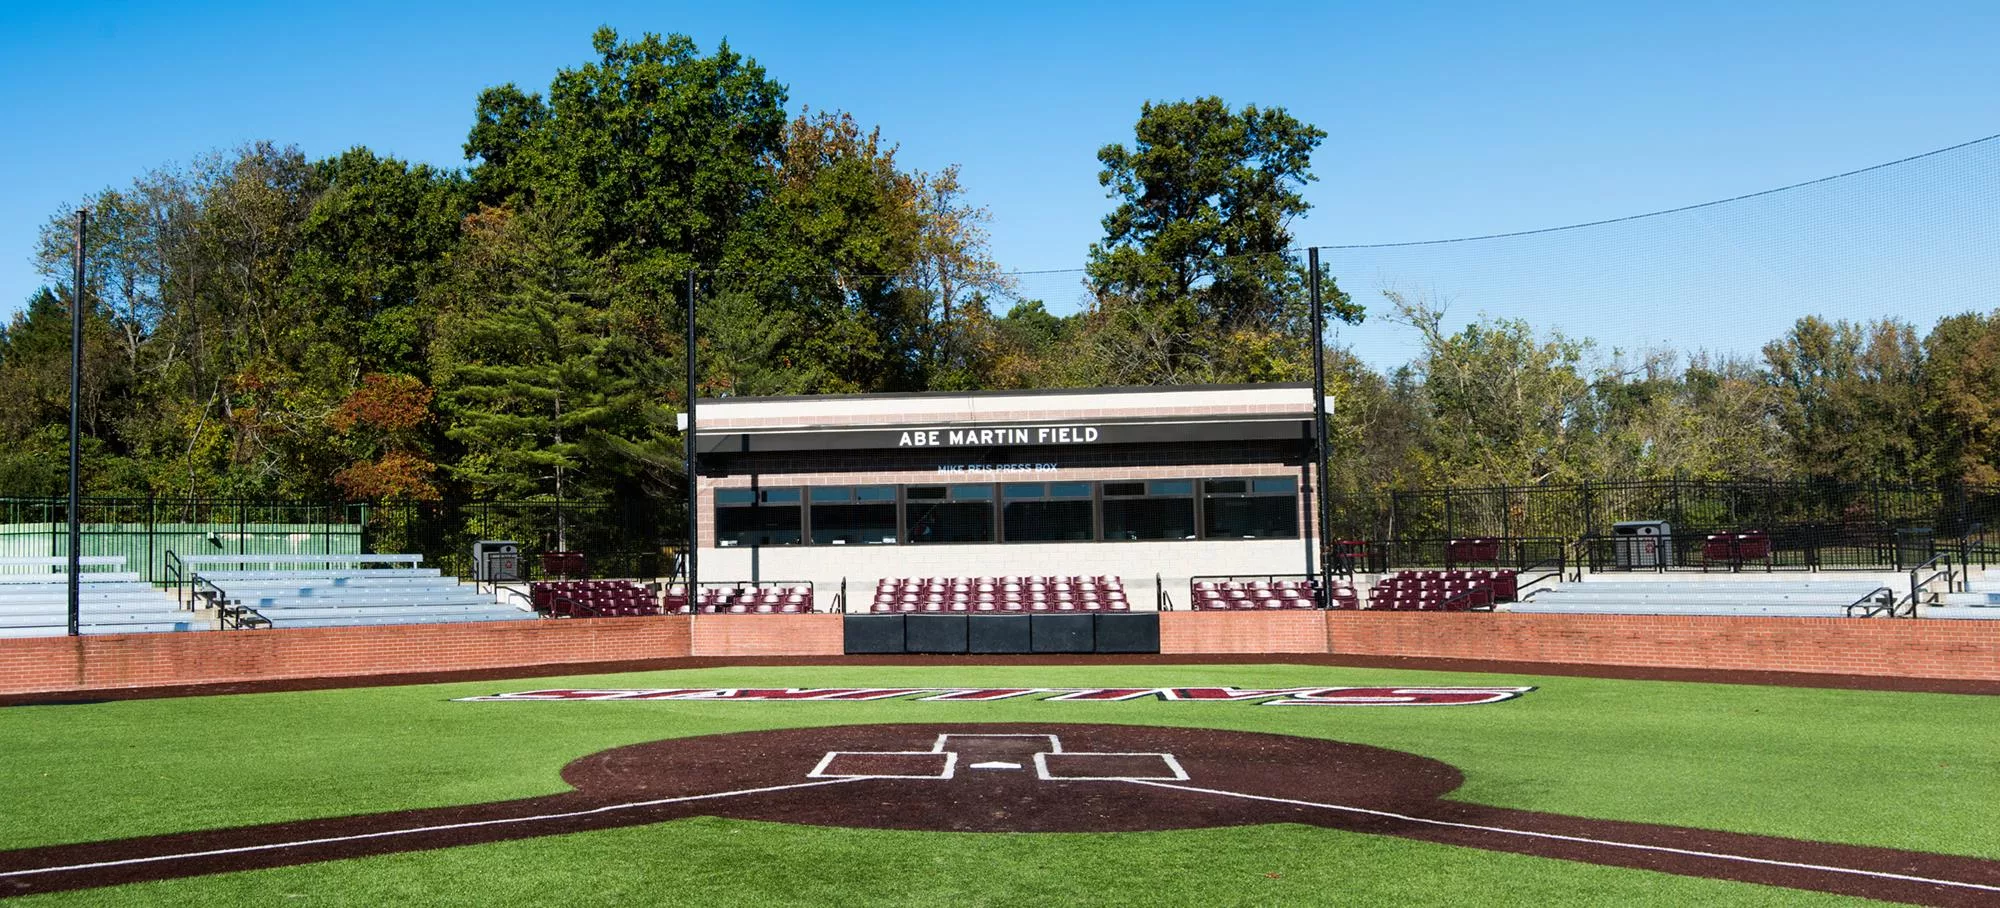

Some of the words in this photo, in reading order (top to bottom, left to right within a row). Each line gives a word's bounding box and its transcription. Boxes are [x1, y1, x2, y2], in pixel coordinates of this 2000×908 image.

[900, 431, 940, 446] ABE
[950, 429, 1029, 445] MARTIN
[1039, 427, 1099, 443] FIELD
[938, 465, 965, 475] MIKE
[996, 463, 1032, 473] PRESS
[1035, 462, 1058, 472] BOX
